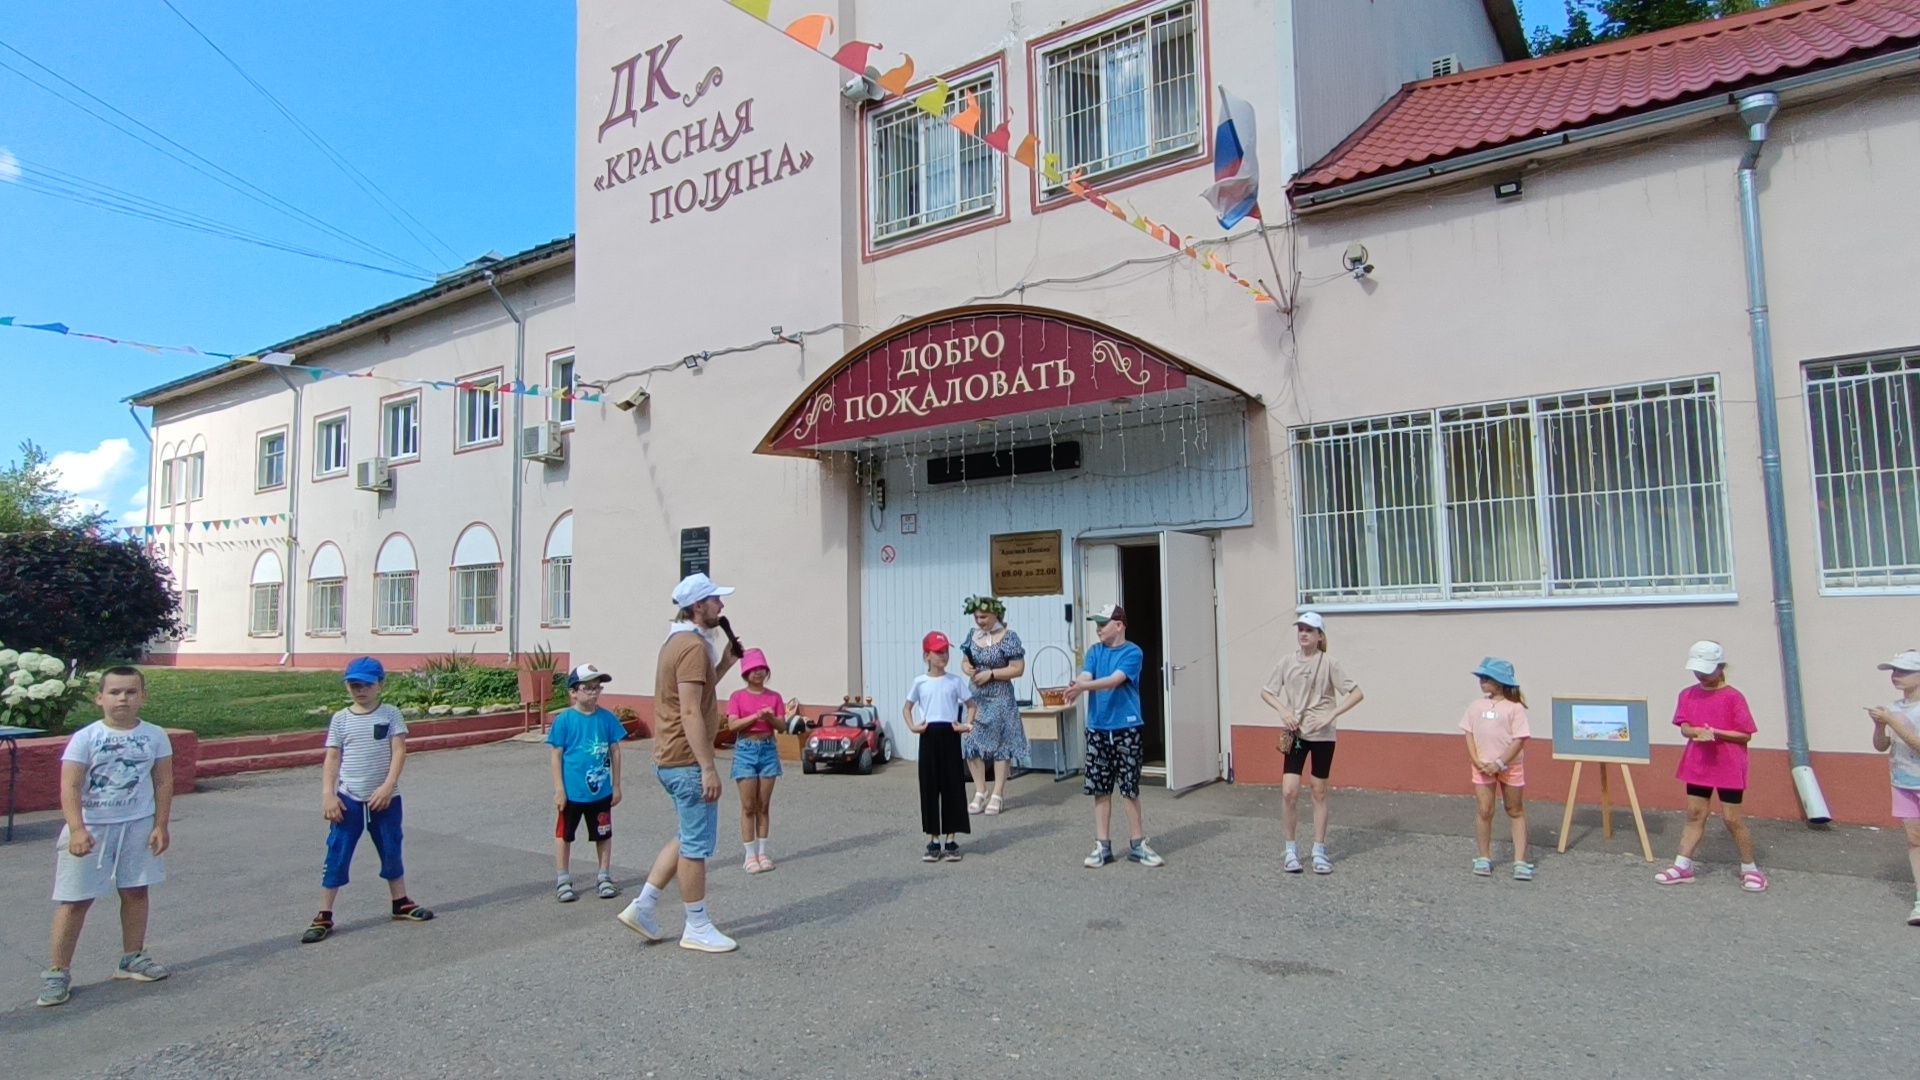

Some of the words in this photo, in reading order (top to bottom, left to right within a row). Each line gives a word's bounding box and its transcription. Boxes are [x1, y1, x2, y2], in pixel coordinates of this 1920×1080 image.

[598, 34, 683, 143] ДК
[593, 98, 755, 192] «КРАСНАЯ
[649, 141, 815, 224] ПОЛЯНА»
[843, 357, 1076, 424] ПОЖАЛОВАТЬ
[896, 330, 1005, 380] ДОБРО
